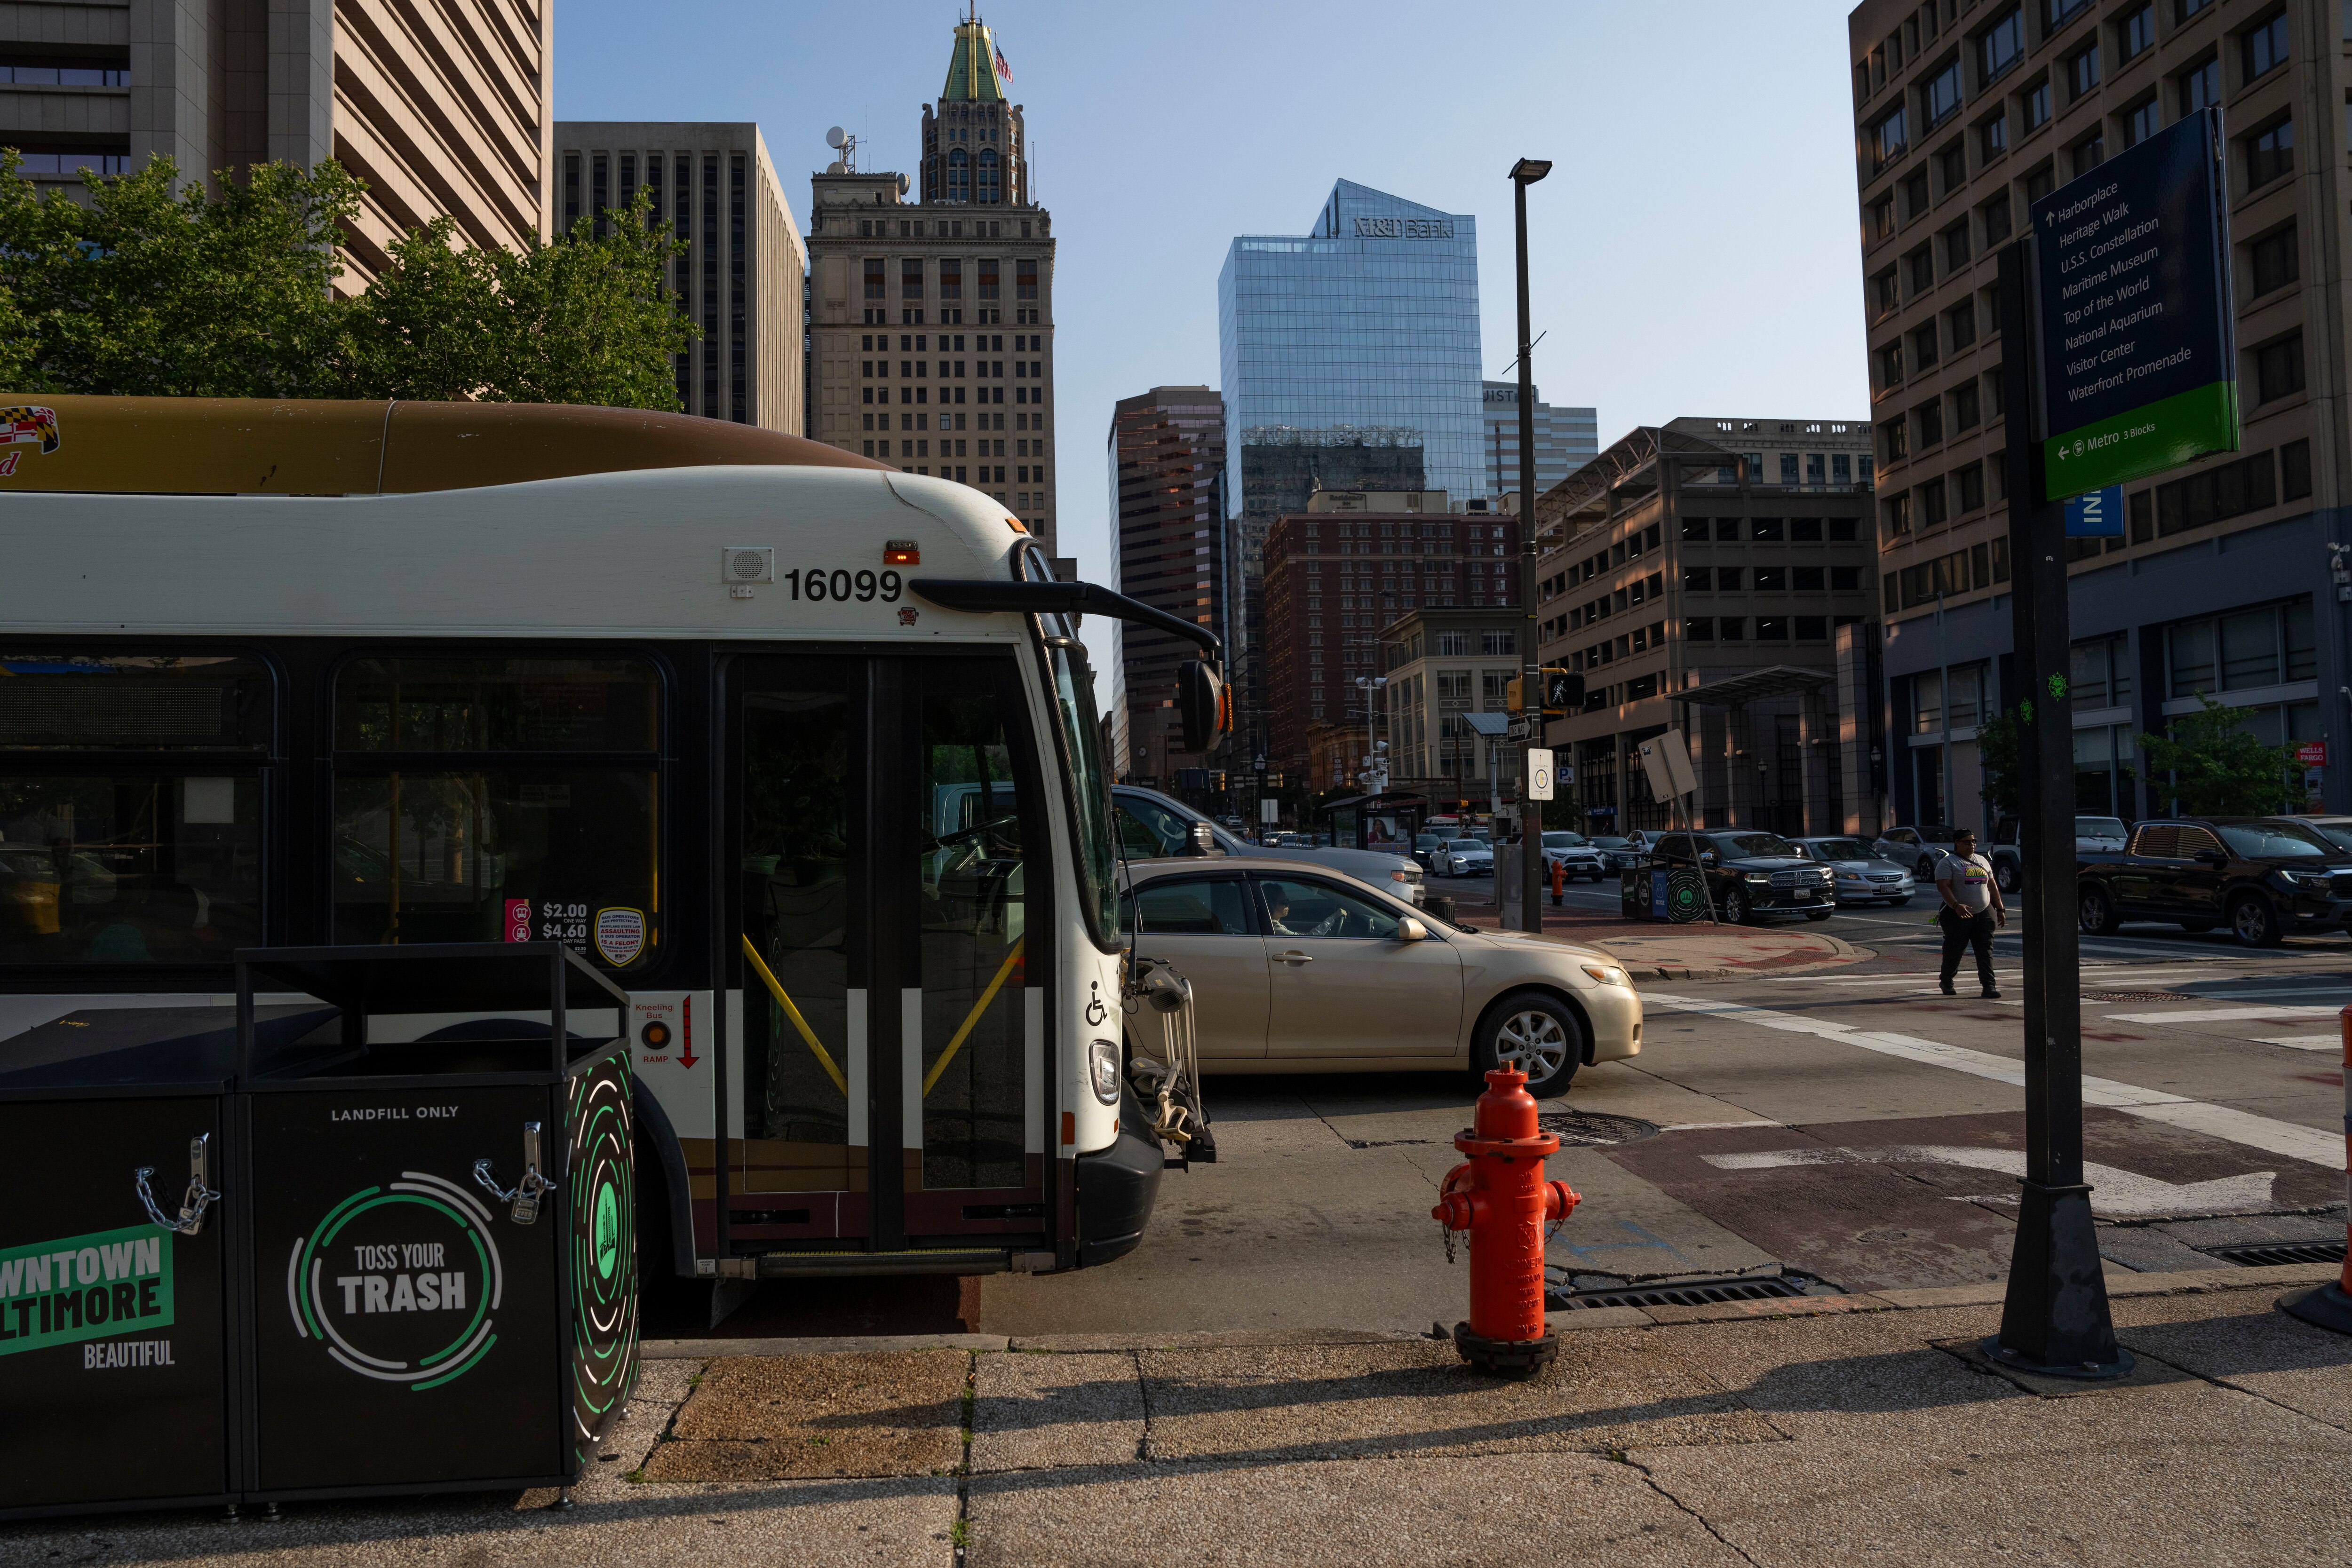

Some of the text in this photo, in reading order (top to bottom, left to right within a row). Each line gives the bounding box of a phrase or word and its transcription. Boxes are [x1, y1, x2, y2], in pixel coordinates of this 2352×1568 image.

[2058, 181, 2118, 223] Harborplace
[1354, 218, 1453, 239] M&T Bank
[2060, 203, 2129, 248] Heritage Walk
[2061, 217, 2159, 274] U.S.S. Constellation
[2063, 245, 2158, 300] Maritime Museum
[2064, 276, 2149, 326] Top of the World
[2066, 301, 2162, 351] National Aquarium
[2066, 339, 2135, 376] Visitor Center
[2068, 348, 2191, 402] Waterfront Promenade
[2088, 422, 2155, 451] Metro 3 Blocks
[785, 570, 901, 602] 16099
[1559, 768, 1568, 779] P
[543, 902, 587, 918] $2.00
[543, 923, 587, 938] $4.60
[332, 1106, 459, 1121] LANDFILL ONLY
[354, 1243, 445, 1271] TOSS YOUR
[1502, 1256, 1542, 1270] KENNEDY
[337, 1272, 466, 1315] TRASH
[85, 1340, 175, 1369] BEAUTIFUL
